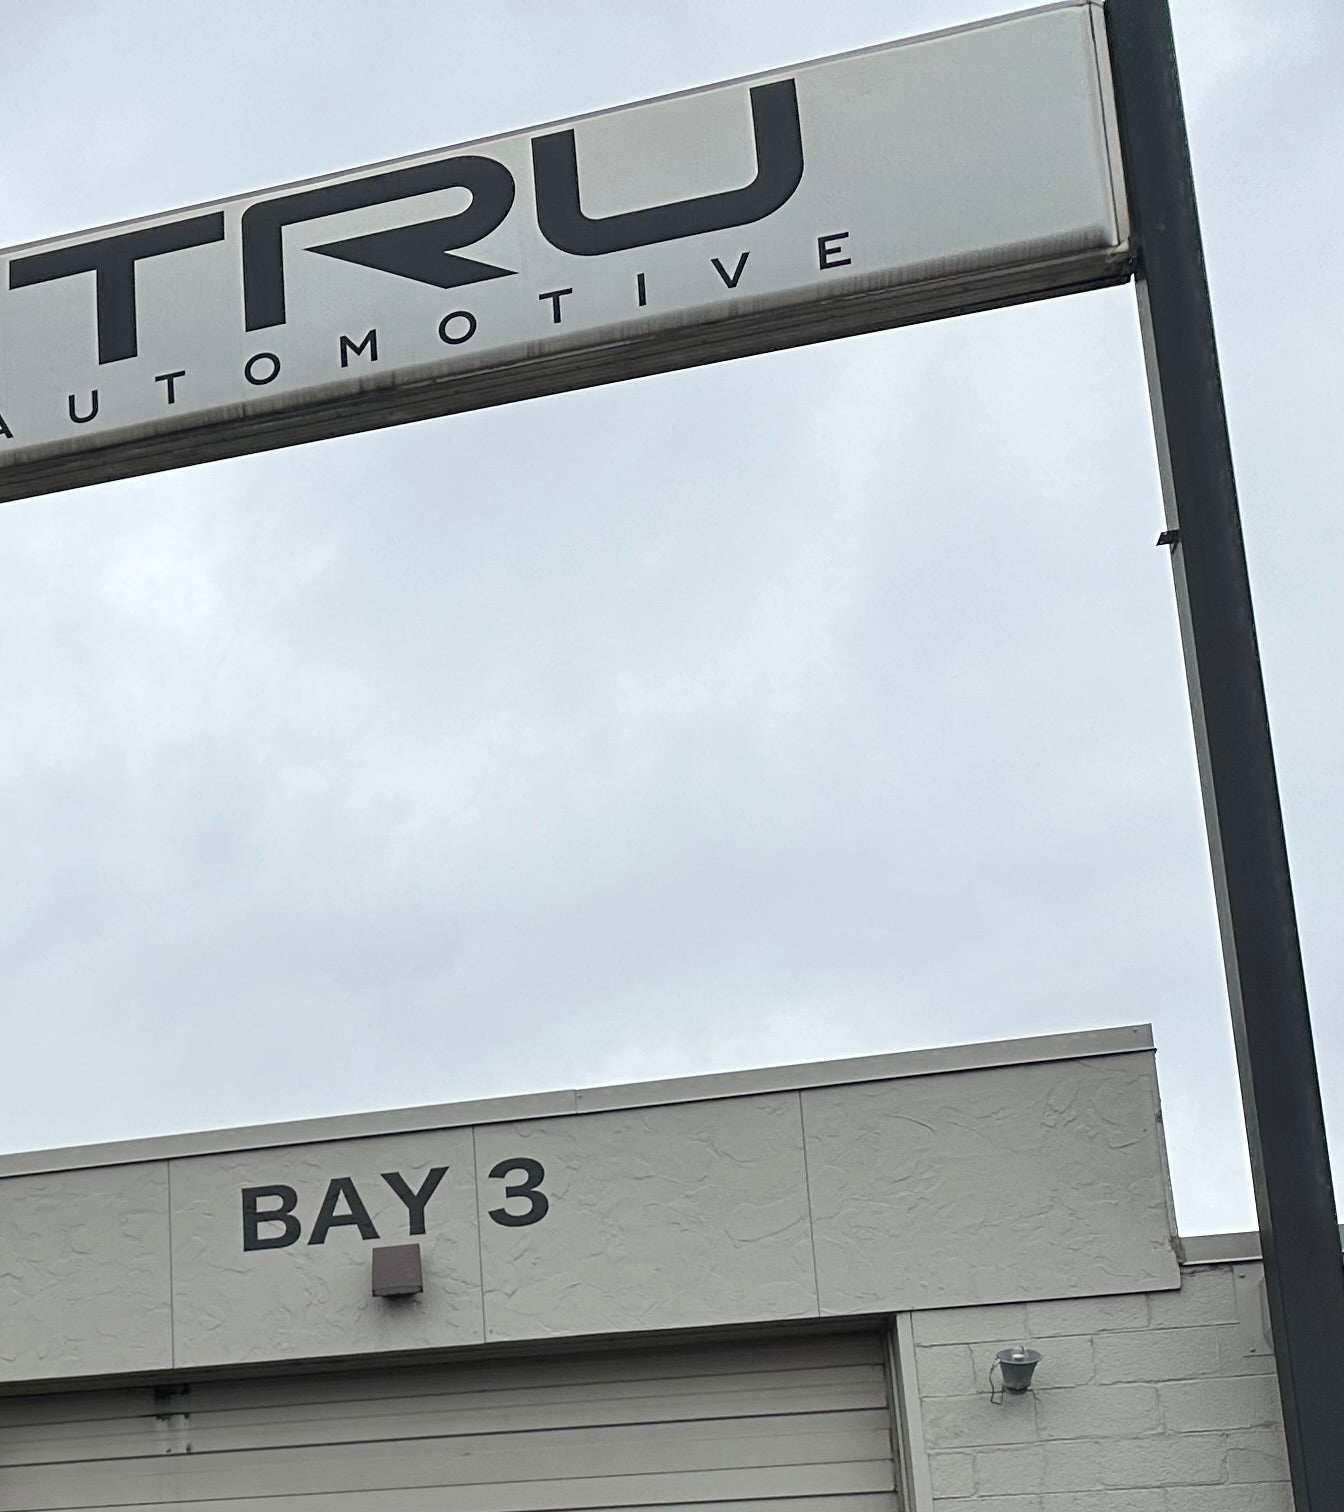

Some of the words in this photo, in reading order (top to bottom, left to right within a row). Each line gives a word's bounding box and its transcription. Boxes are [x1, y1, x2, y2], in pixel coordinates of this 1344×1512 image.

[9, 78, 805, 366] TRU
[241, 1166, 450, 1252] BAY
[487, 1157, 550, 1227] 3
